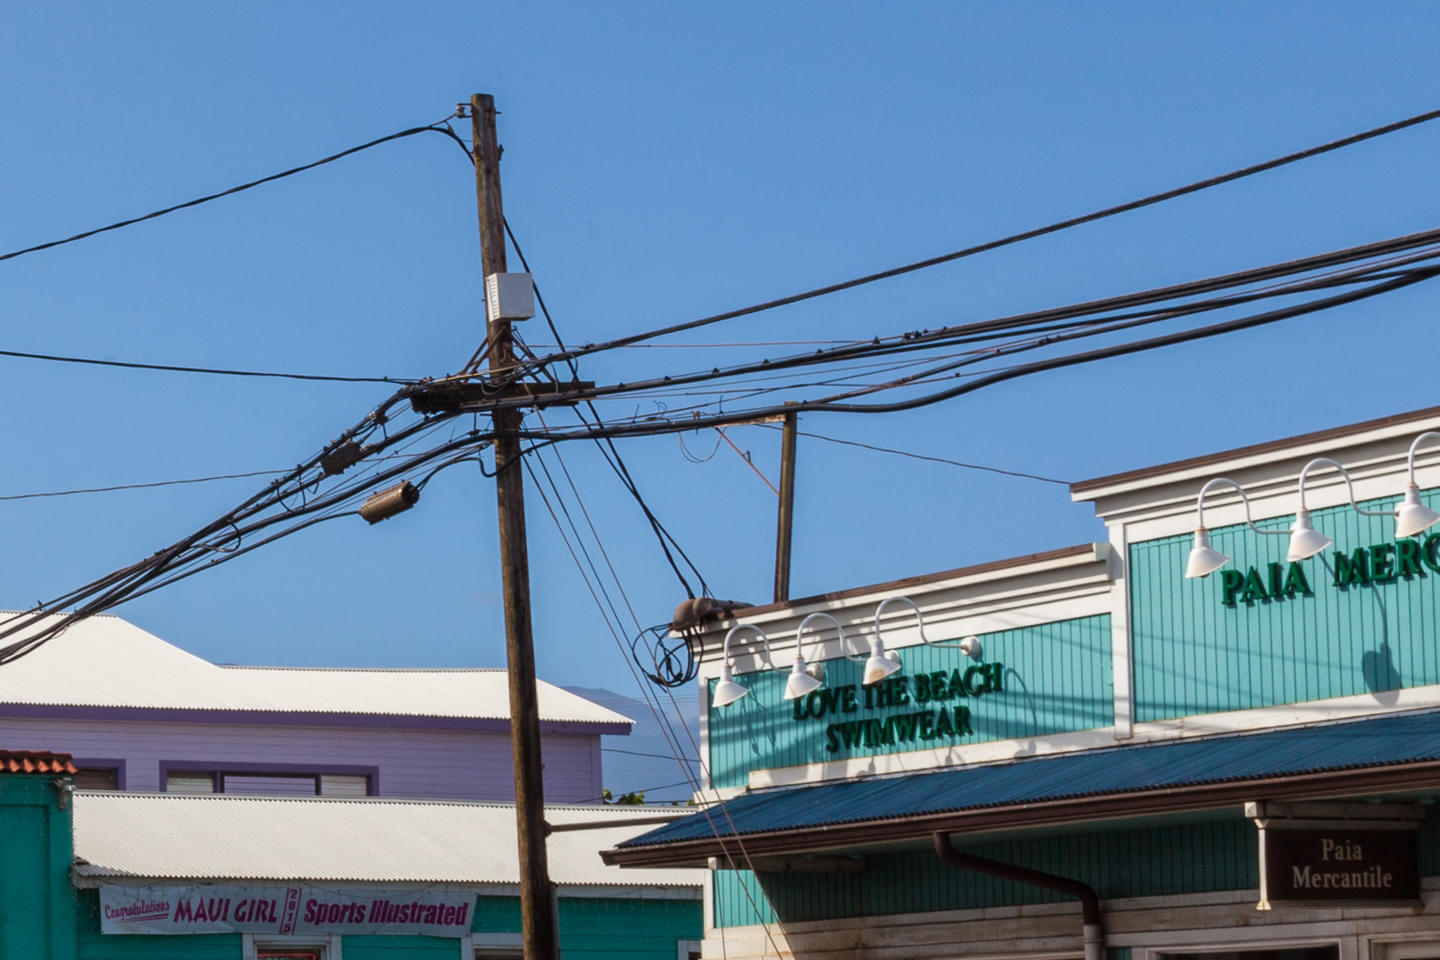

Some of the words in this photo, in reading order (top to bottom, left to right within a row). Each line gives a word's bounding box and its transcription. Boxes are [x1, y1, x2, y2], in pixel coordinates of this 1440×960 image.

[1220, 561, 1312, 606] PAIA
[792, 684, 857, 721] LOVE
[861, 675, 908, 710] THE
[913, 661, 1003, 704] BEACH
[826, 705, 973, 753] SWIMWEAR
[1320, 838, 1363, 861] Paia
[1291, 865, 1393, 889] Mercantile
[104, 899, 170, 921] Congratulations
[173, 897, 232, 924] MAUI
[233, 899, 278, 924] GIRL
[303, 898, 367, 926] Sports
[368, 900, 470, 926] Illustrated
